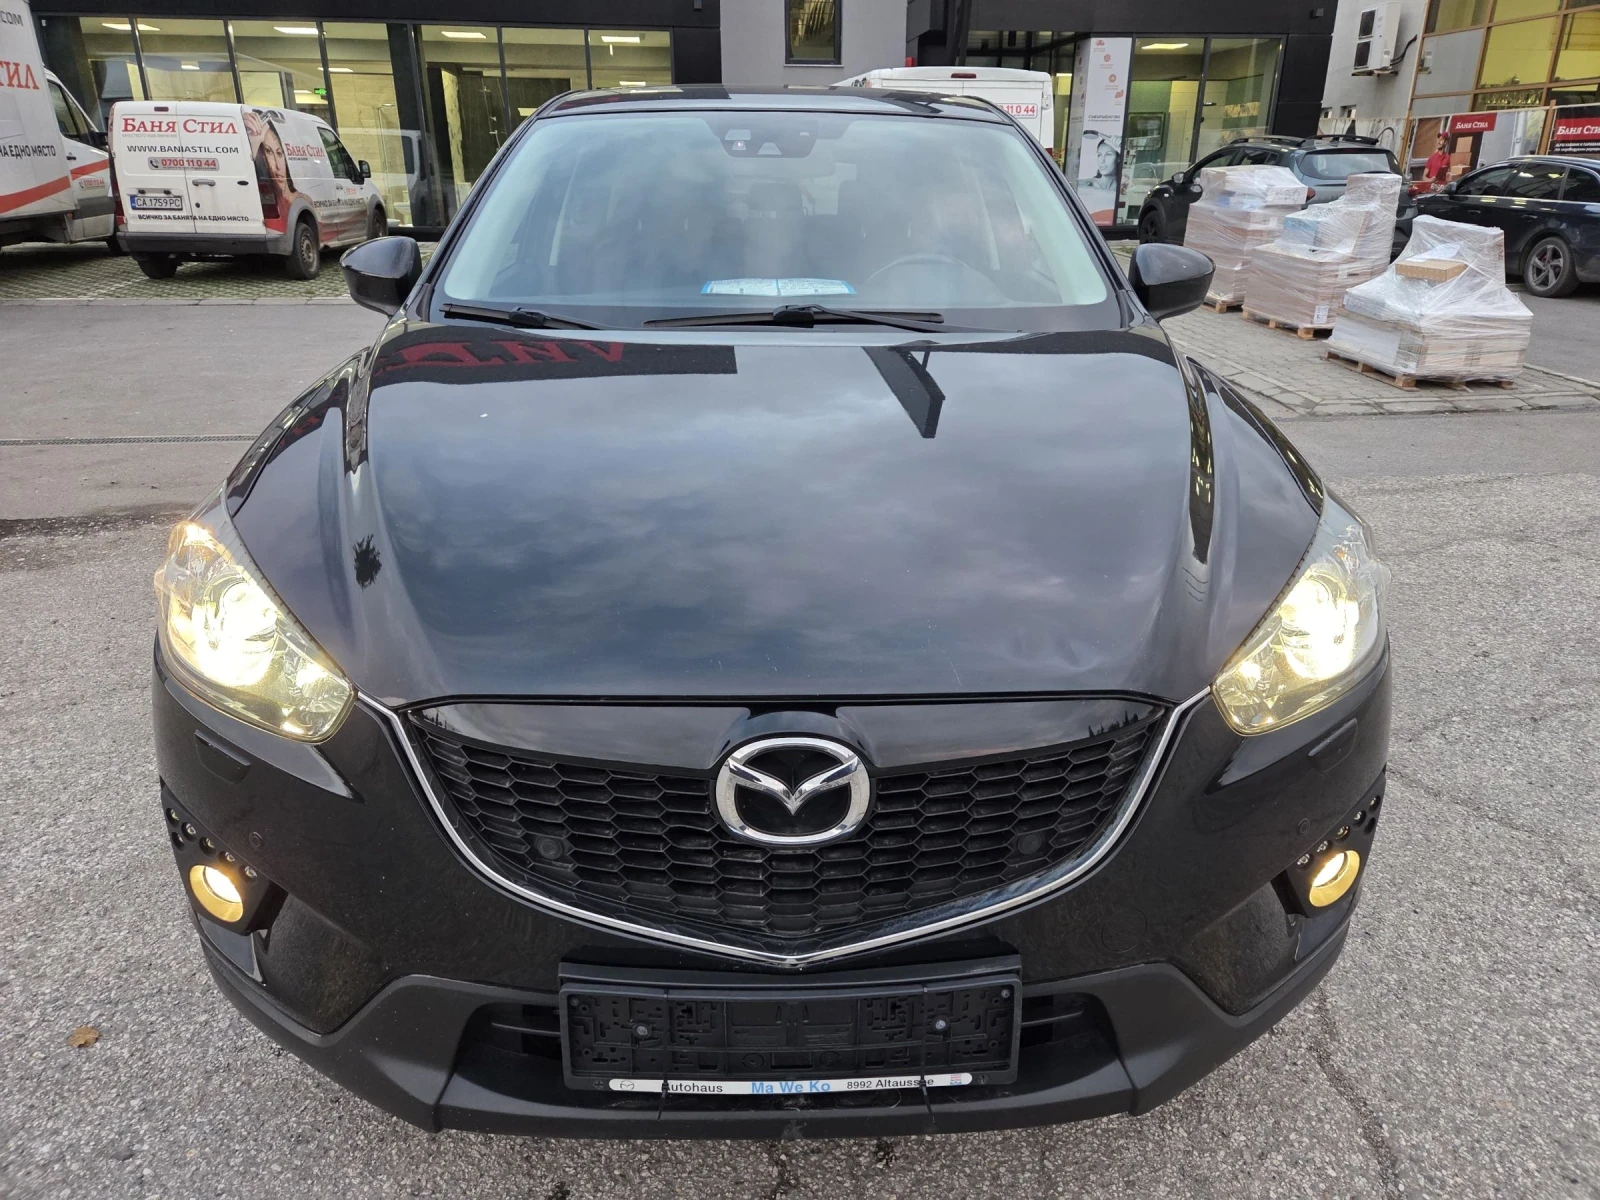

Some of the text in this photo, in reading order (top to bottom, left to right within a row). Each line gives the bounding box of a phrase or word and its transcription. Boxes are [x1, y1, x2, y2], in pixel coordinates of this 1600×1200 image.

[1023, 105, 1035, 114] 44
[9, 145, 31, 160] ЕДНО
[31, 145, 56, 157] МЯСТО
[127, 145, 239, 154] WWW.BANIASTIL.COM
[161, 158, 184, 167] 0700
[149, 198, 168, 208] 1759
[751, 1082, 774, 1094] Ma
[779, 1081, 803, 1093] We
[809, 1080, 831, 1092] Ko
[846, 1081, 872, 1090] 8992
